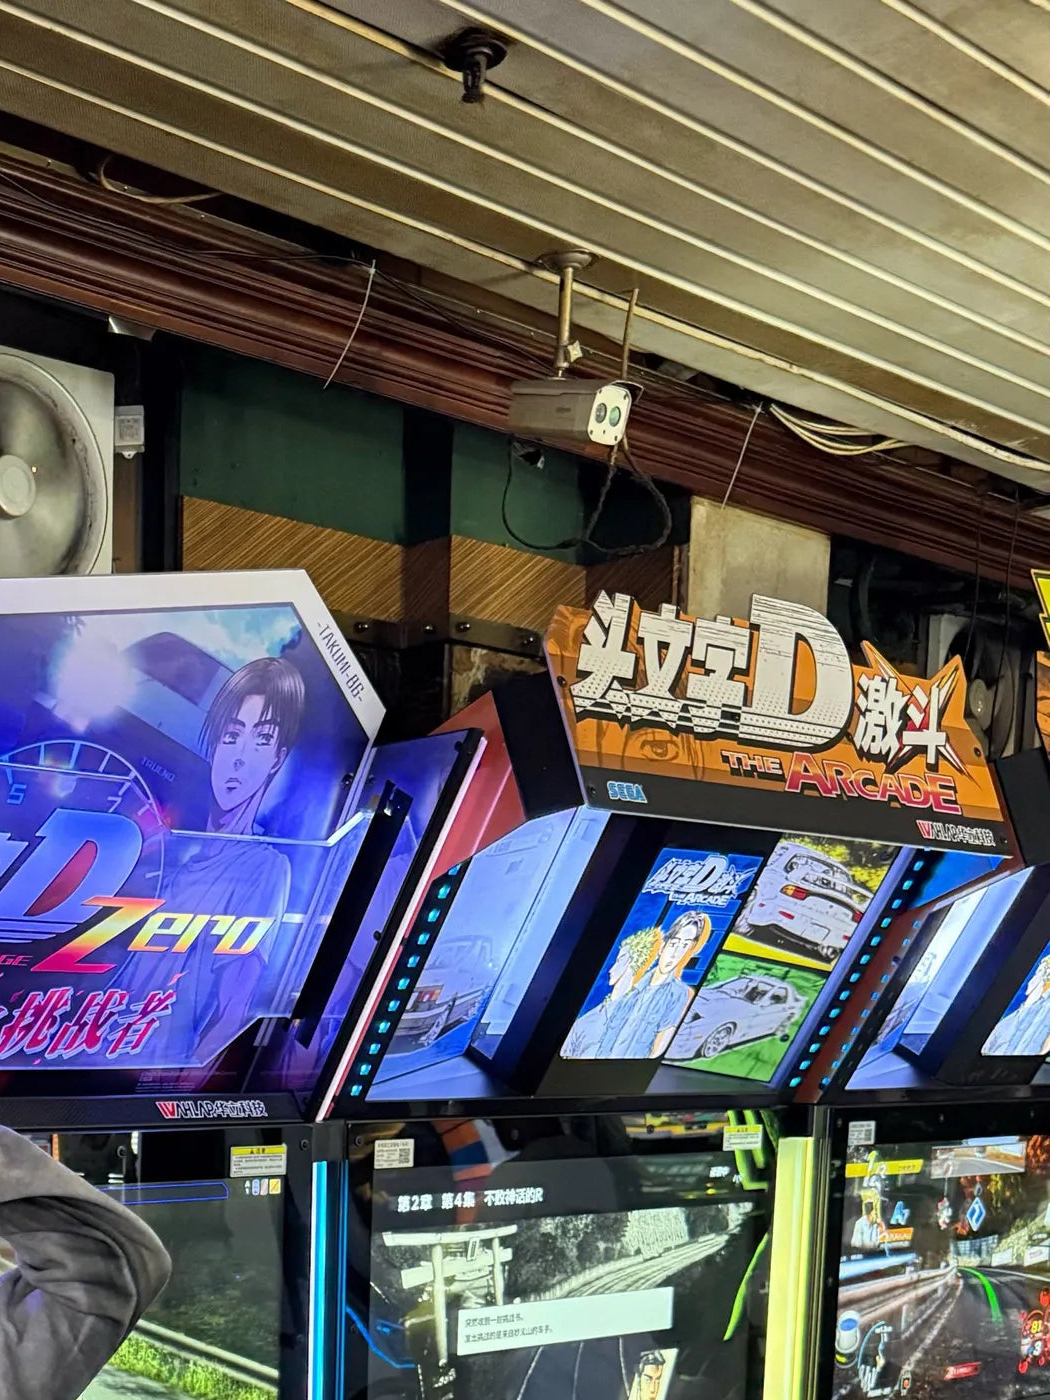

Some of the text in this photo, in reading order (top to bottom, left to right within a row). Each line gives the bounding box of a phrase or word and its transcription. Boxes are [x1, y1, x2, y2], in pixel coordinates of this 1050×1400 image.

[854, 673, 948, 766] 激斗
[606, 780, 649, 804] SEGA
[720, 750, 963, 816] THE ARCADE
[31, 896, 277, 974] Zero
[397, 1194, 433, 1213] 第2章
